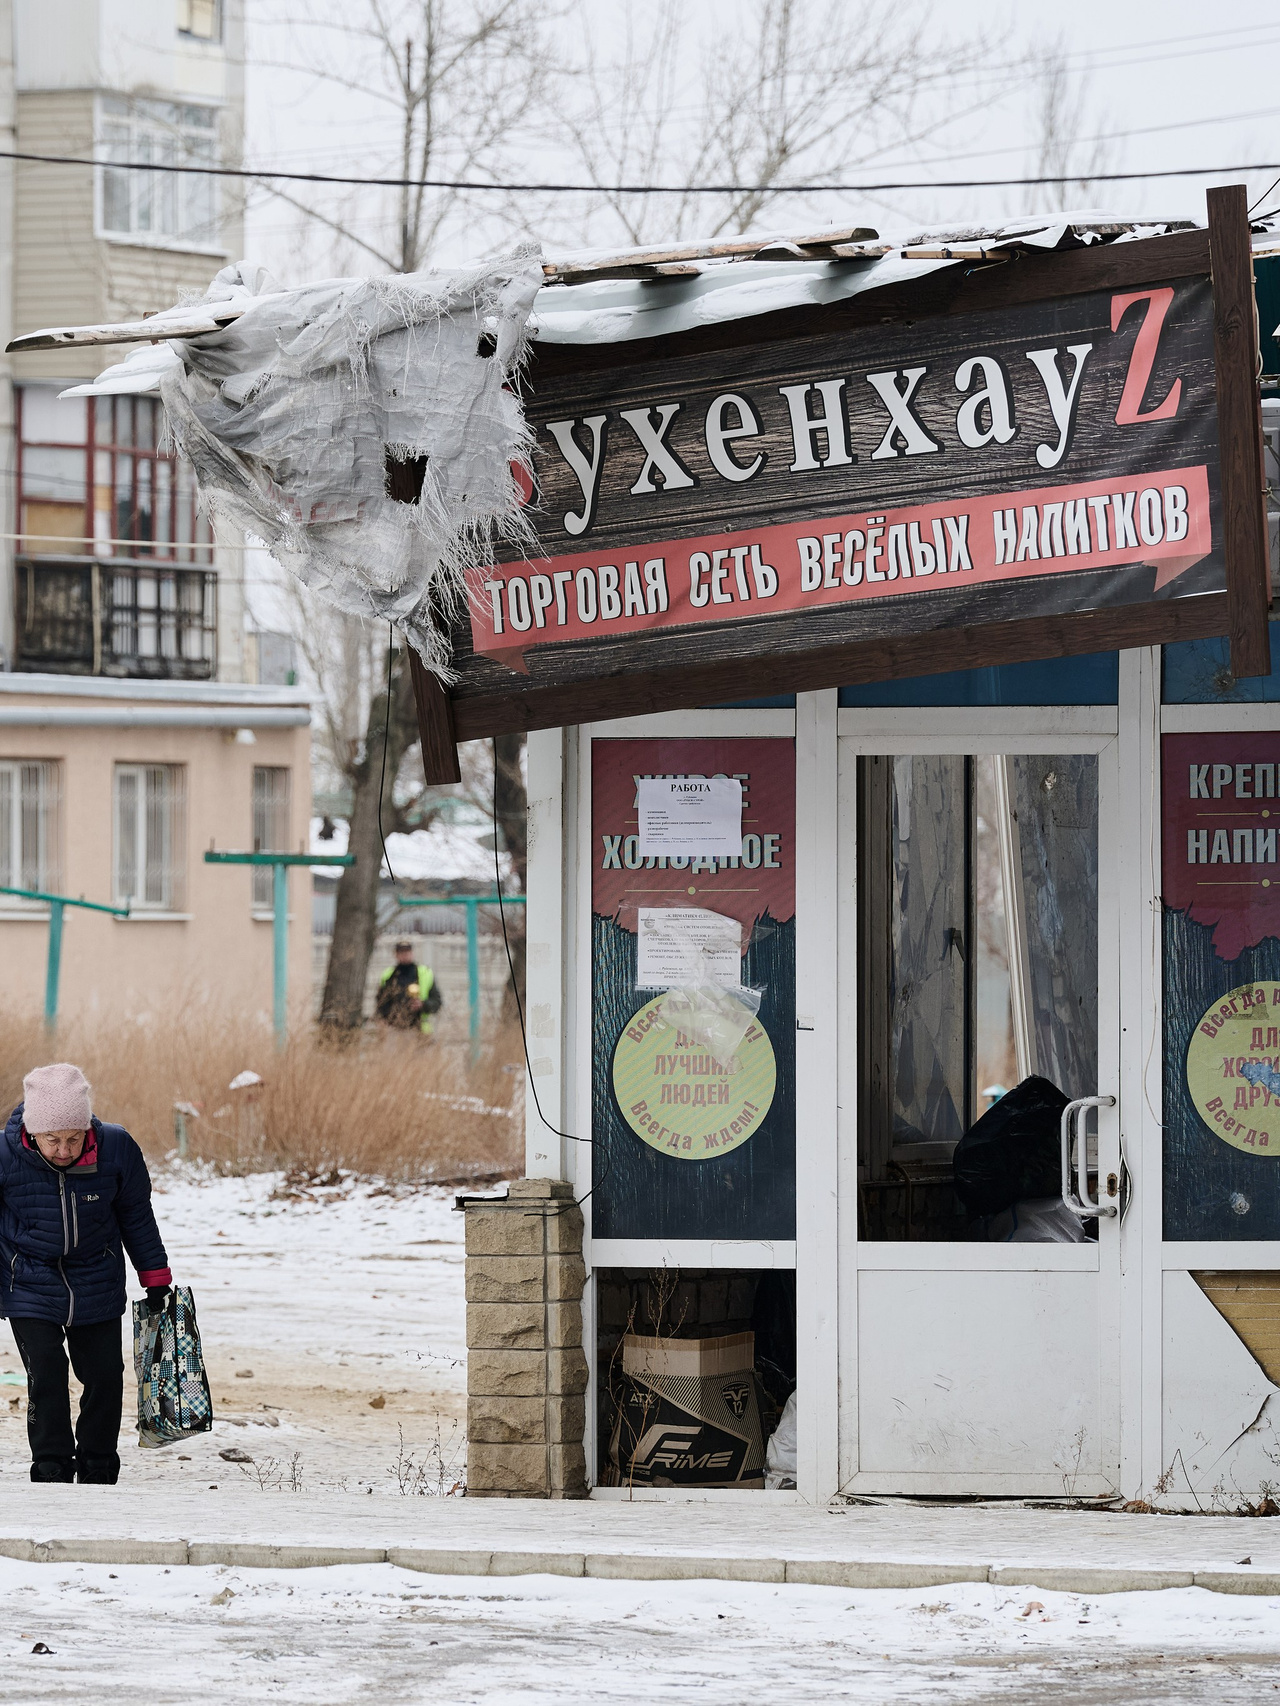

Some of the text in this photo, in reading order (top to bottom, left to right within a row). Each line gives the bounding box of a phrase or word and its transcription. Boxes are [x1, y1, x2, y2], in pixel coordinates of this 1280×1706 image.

[503, 286, 1183, 536] ухенхауZ
[484, 485, 1190, 635] ТОРГОВАЯ СЕТЬ ВЕСЁЛЫХ НАПИТКОВ
[670, 783, 711, 793] РАБОТА
[1189, 763, 1280, 799] КРЕП
[1187, 828, 1280, 864] НАПИ
[1199, 988, 1266, 1039] Всегда
[1250, 1027, 1280, 1051] ДЛ
[659, 1079, 730, 1107] ЛЮДЕЙ
[630, 1099, 760, 1150] Всегда ждем!
[1205, 1096, 1270, 1147] Всегда
